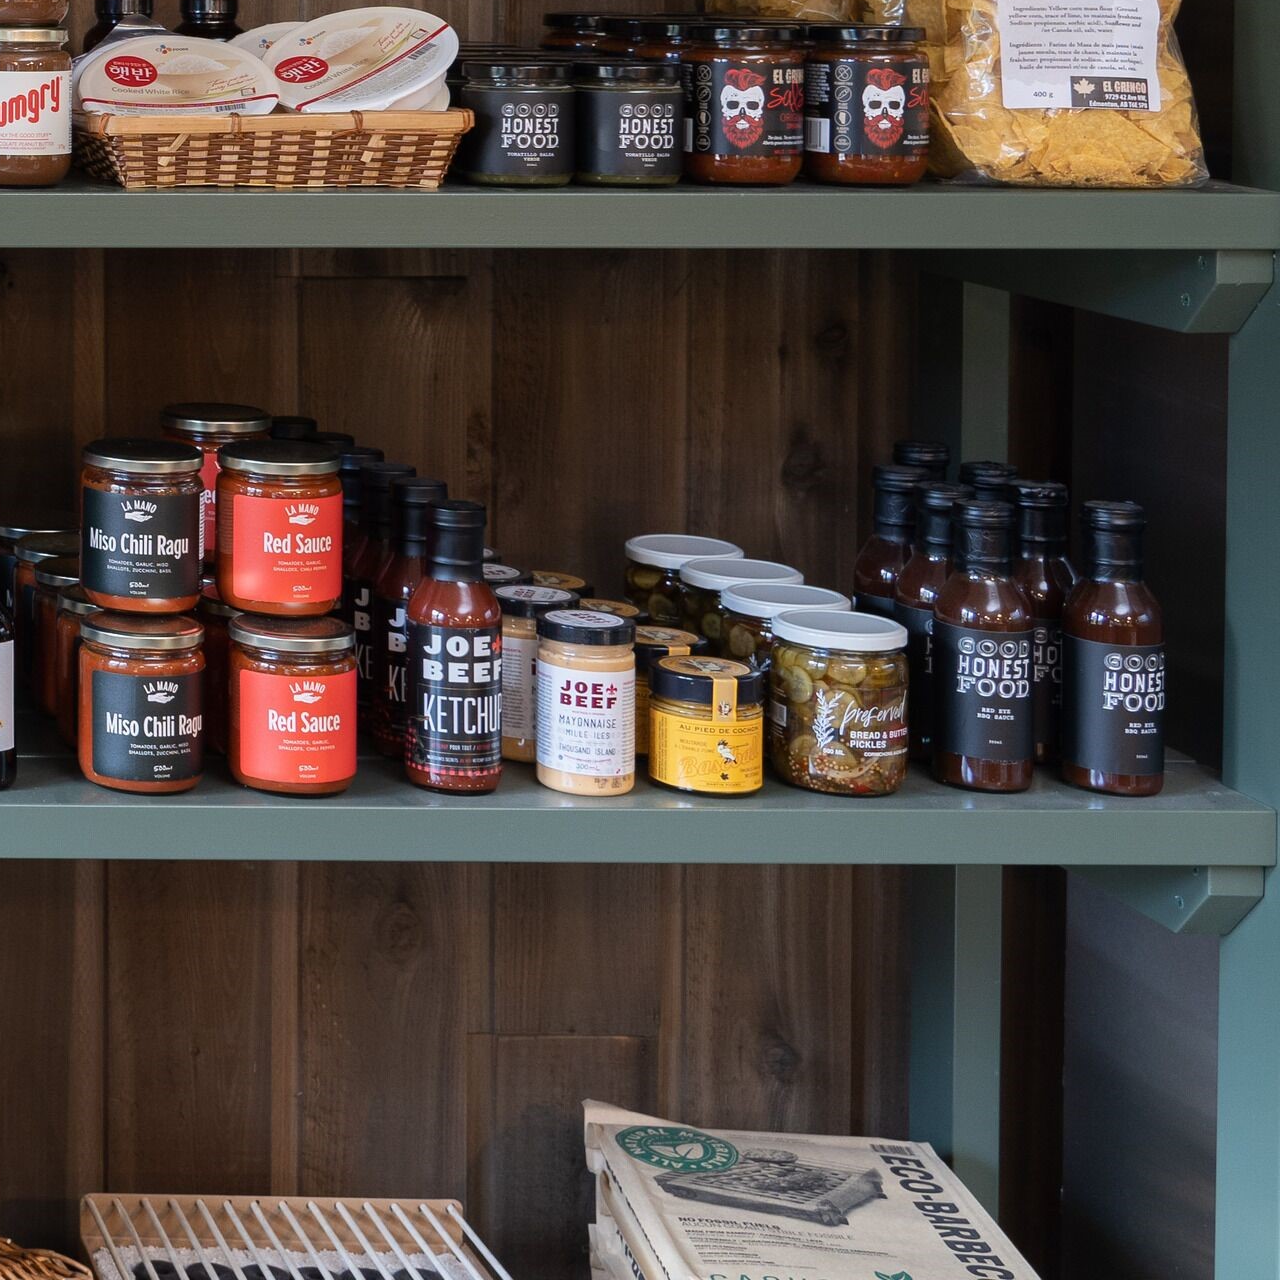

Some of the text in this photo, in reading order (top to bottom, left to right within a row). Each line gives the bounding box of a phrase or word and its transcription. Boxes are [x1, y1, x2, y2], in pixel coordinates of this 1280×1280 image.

[109, 65, 152, 82] 햇반
[112, 86, 143, 94] Cooked
[501, 103, 559, 117] GOOD
[502, 118, 559, 134] HONEST
[501, 134, 559, 149] FOOD
[90, 527, 188, 559] Miso Chili Ragu
[263, 531, 332, 553] Red Sauce
[423, 634, 491, 657] JOE
[958, 636, 1030, 658] GOOD
[957, 655, 1029, 679] HONEST
[560, 679, 603, 695] JOE
[957, 676, 1029, 698] FOOD
[560, 692, 617, 709] BEEF
[106, 712, 202, 737] Miso Chili Ragu
[268, 709, 340, 733] Red Sauce
[559, 715, 616, 729] MAYONNAISE
[679, 723, 691, 732] AU
[695, 726, 716, 734] PIED
[733, 726, 758, 734] COCHON
[850, 731, 881, 739] BREAD
[850, 740, 886, 749] PICKLES
